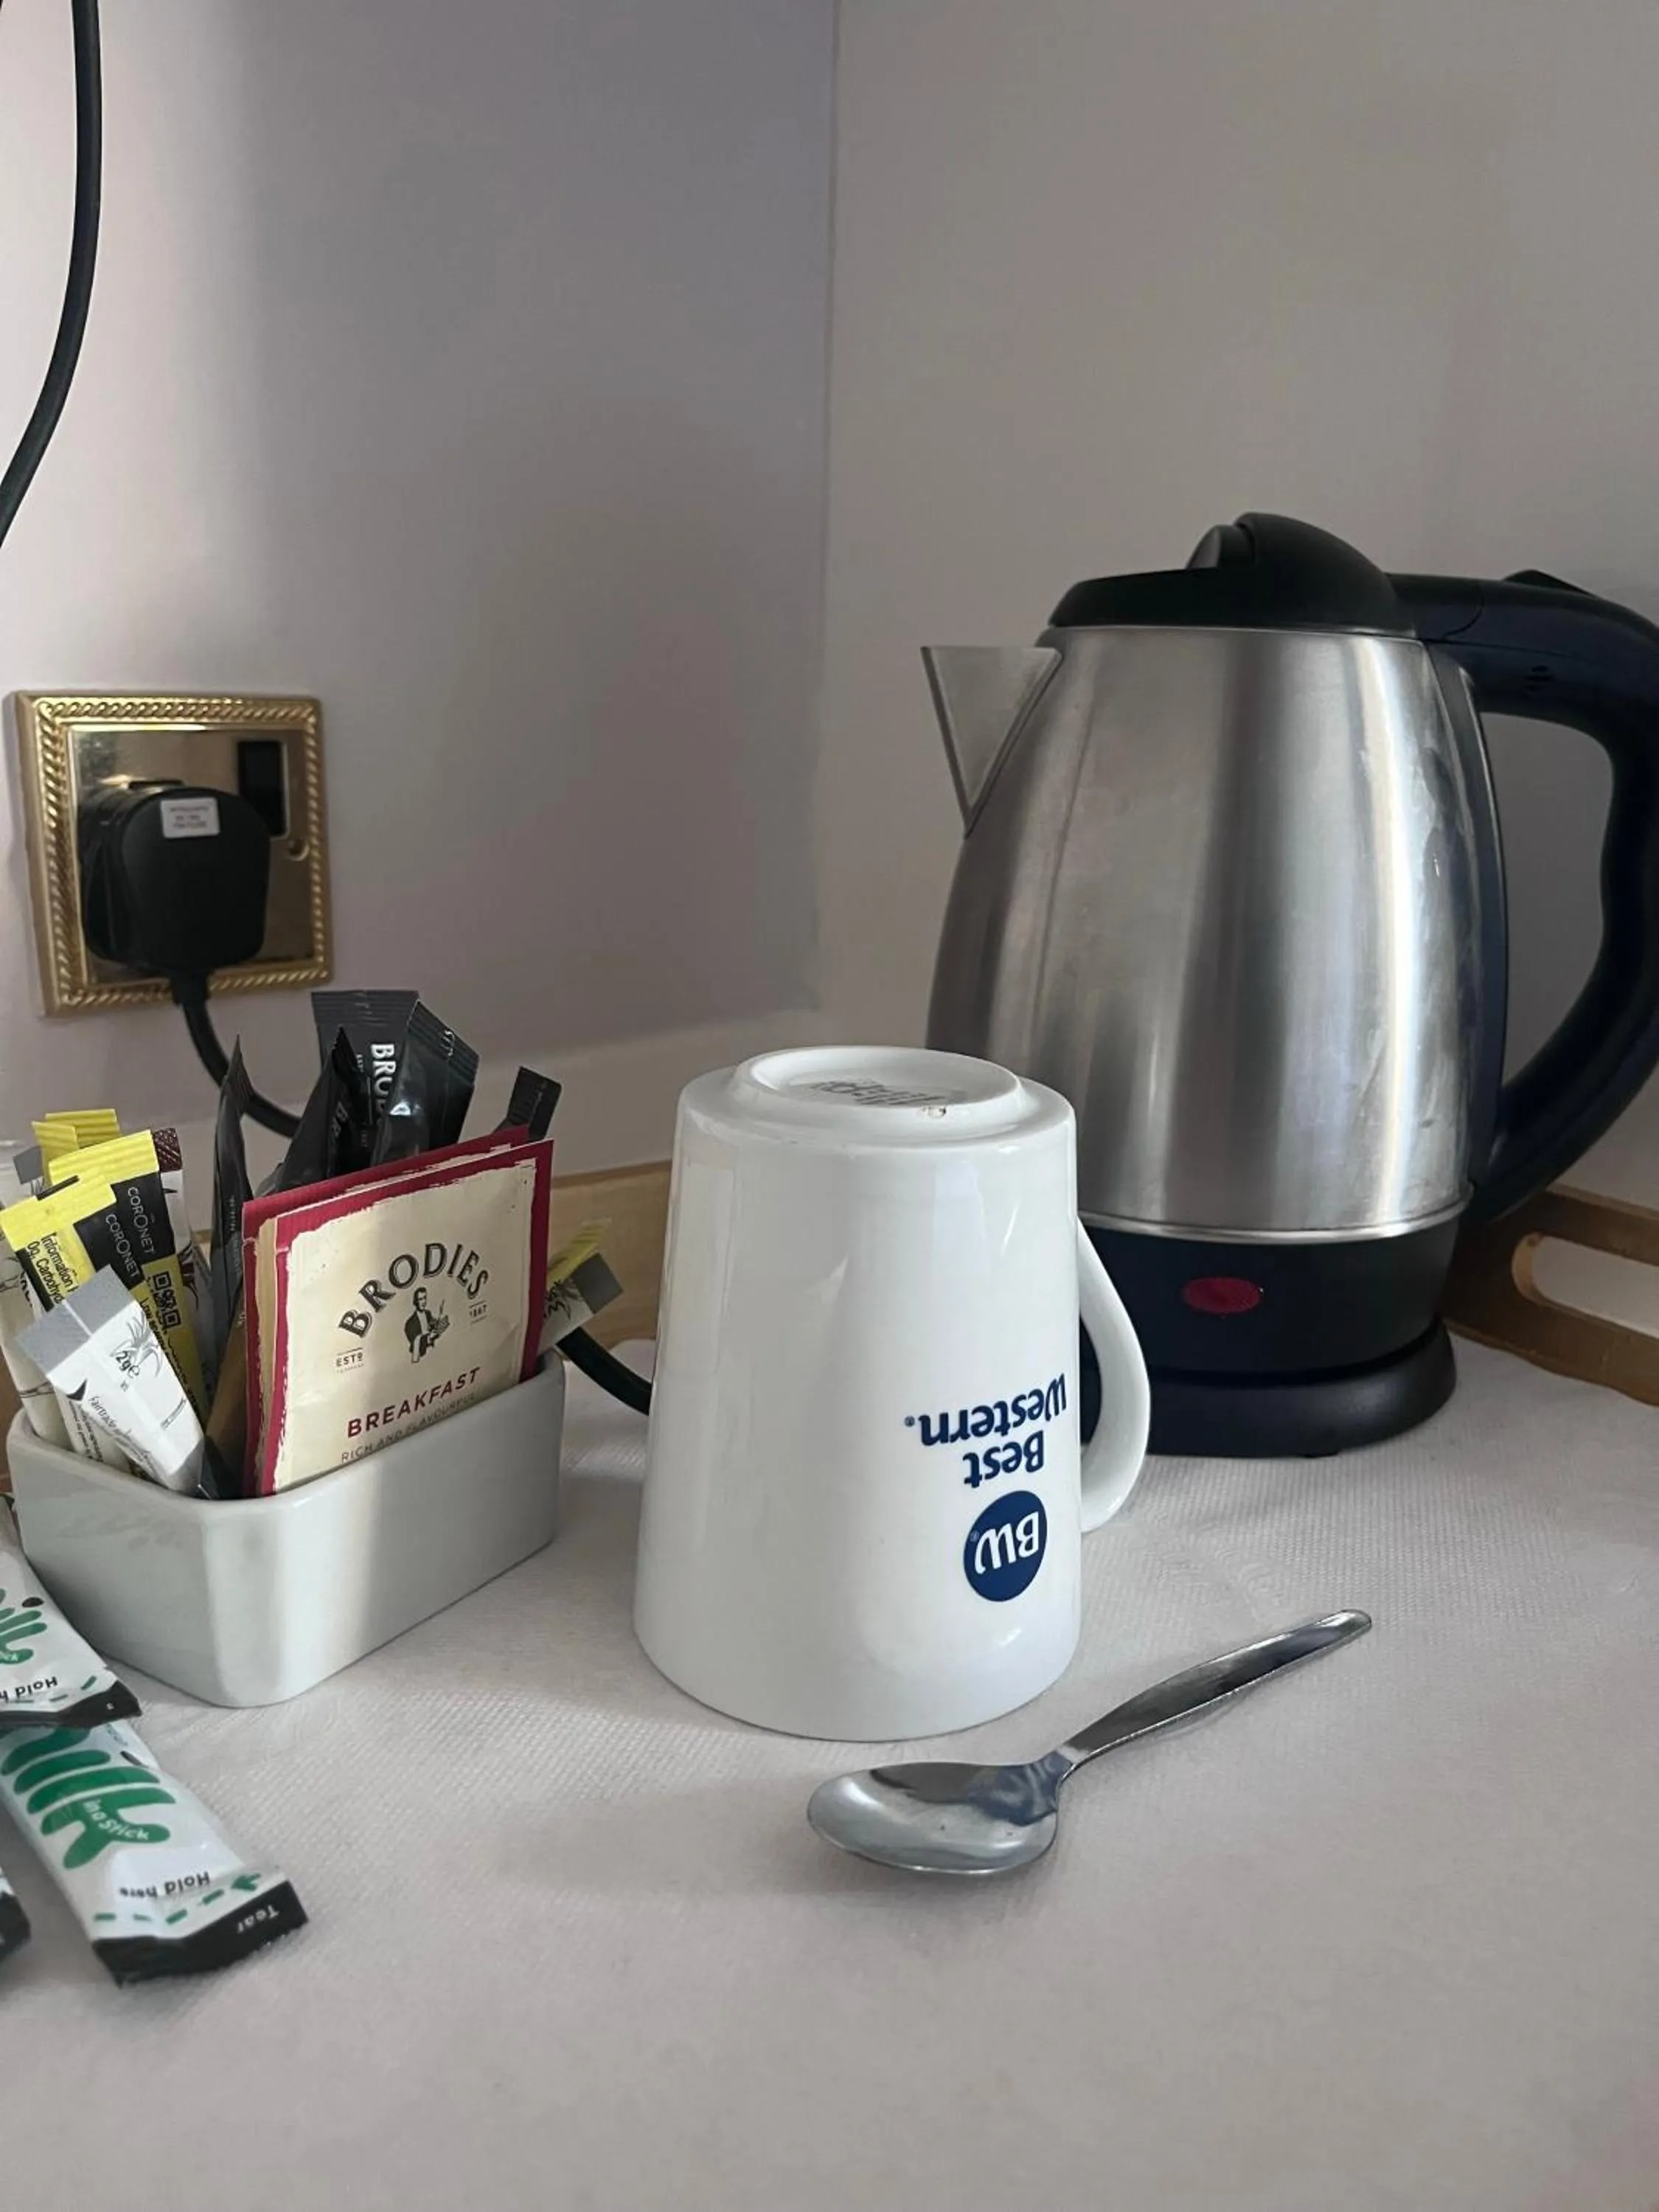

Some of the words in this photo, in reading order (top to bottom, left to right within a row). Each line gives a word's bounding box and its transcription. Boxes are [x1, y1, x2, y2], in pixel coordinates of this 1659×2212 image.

[105, 1214, 140, 1276] CORONET
[128, 1186, 154, 1253] CORONET
[41, 1232, 73, 1287] Information
[338, 1242, 488, 1338] BRODIES
[347, 1367, 480, 1438] BREAKFAST
[341, 1444, 373, 1462] RICH
[963, 1430, 1043, 1488] Best
[975, 1512, 1039, 1574] BW
[15, 1677, 58, 1698] Hold
[98, 1819, 150, 1840] Stick
[164, 1871, 210, 1895] Hold
[237, 1905, 279, 1934] Tear
